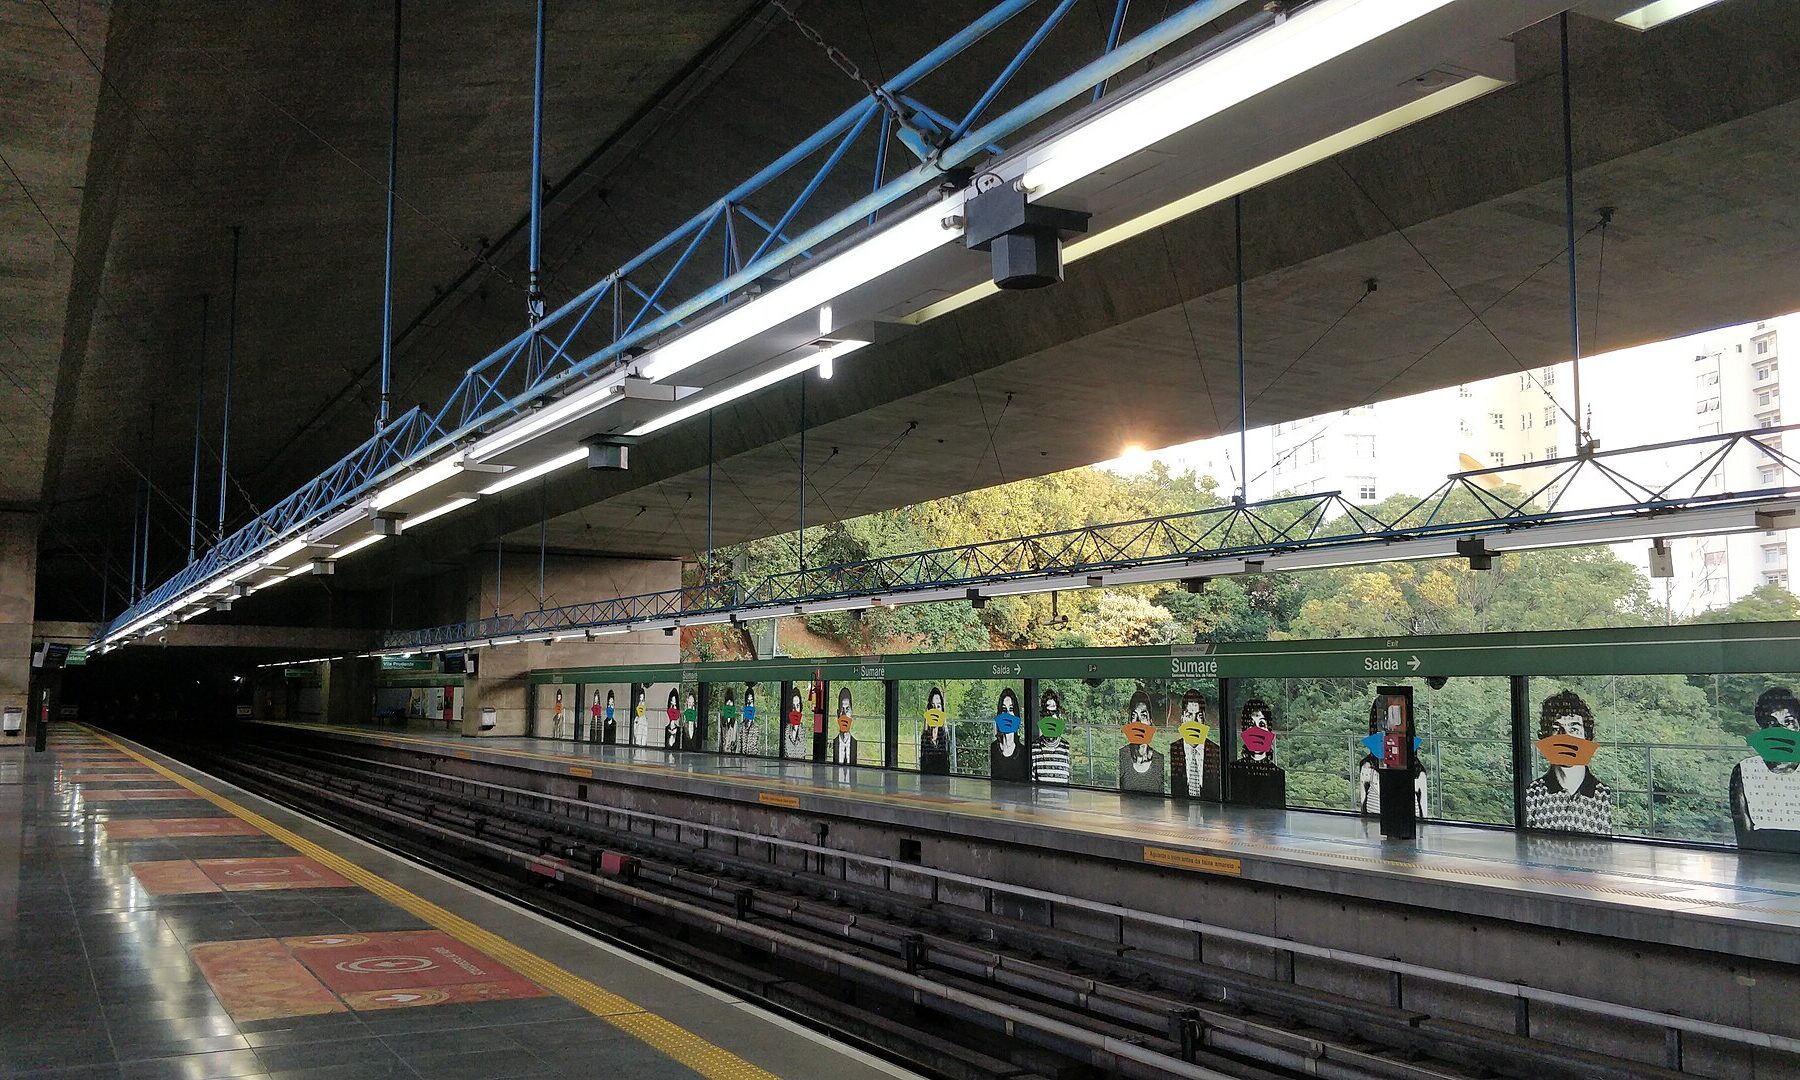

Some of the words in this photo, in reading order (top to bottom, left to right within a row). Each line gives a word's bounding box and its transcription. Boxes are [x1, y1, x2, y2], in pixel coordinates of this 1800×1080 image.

[1171, 658, 1218, 673] Sumaré
[1364, 657, 1399, 670] Saída
[861, 665, 885, 677] Sumaré
